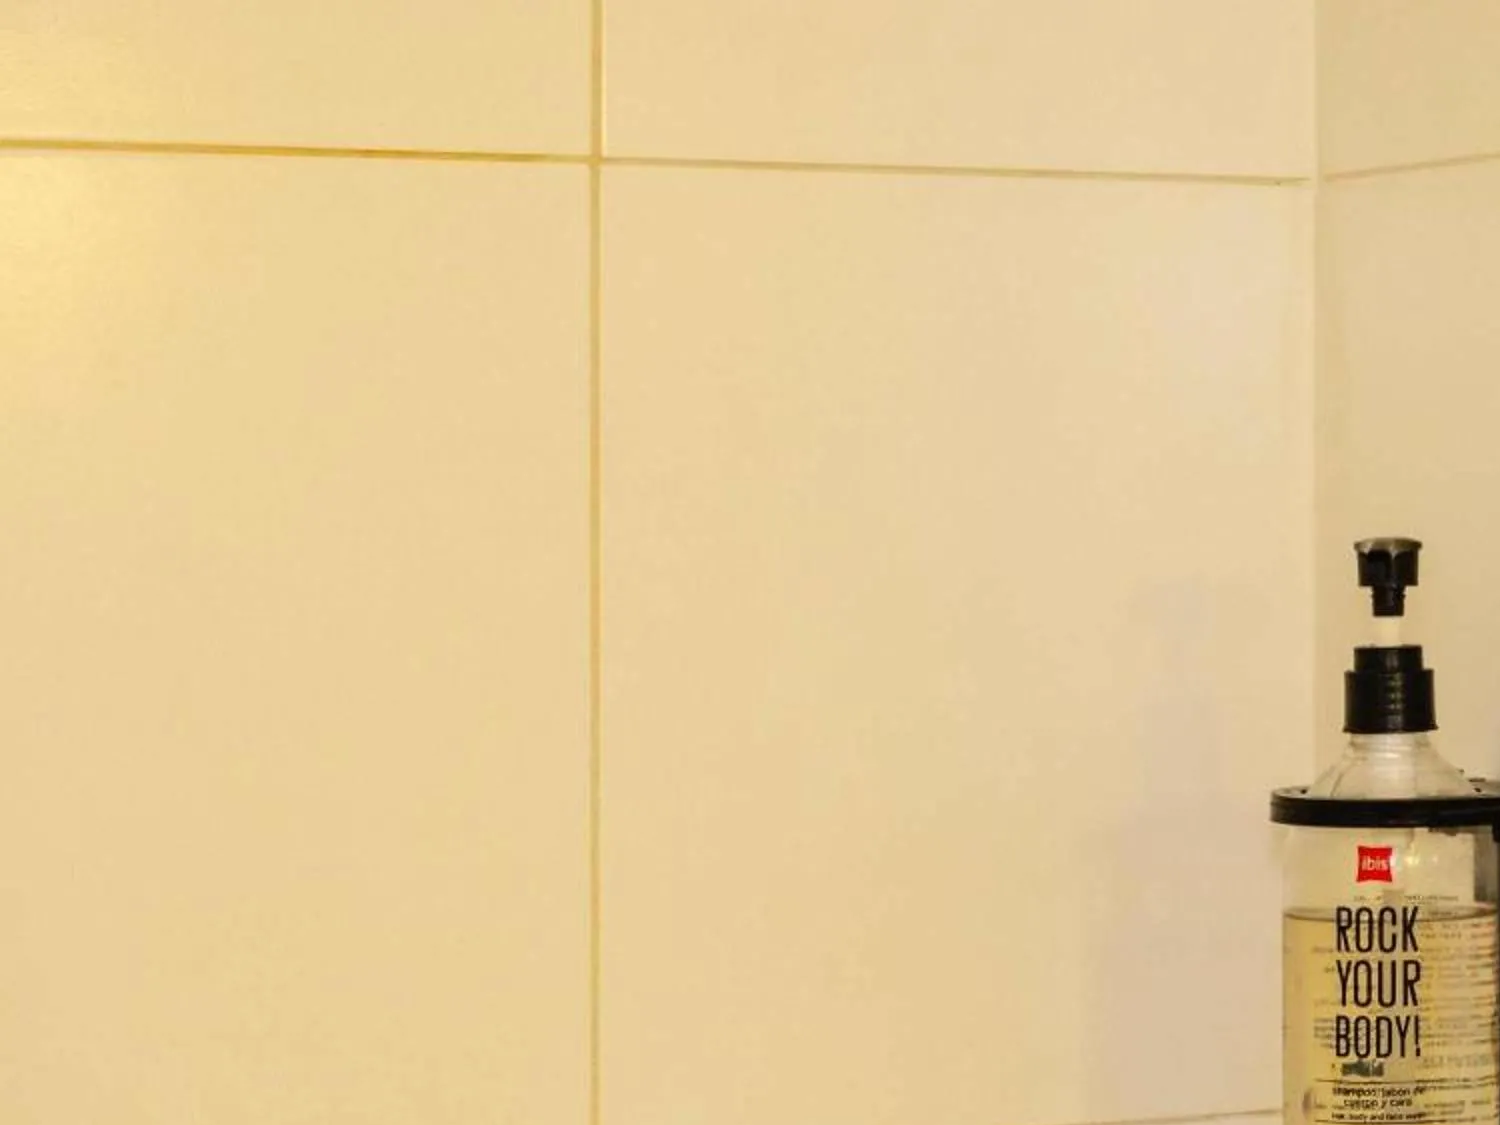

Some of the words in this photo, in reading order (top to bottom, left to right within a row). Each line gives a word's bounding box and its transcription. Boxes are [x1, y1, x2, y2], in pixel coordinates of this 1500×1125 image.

[1361, 855, 1389, 870] ibis
[1335, 906, 1419, 953] ROCK
[1335, 960, 1422, 1008] YOUR
[1335, 1015, 1421, 1058] BODY!
